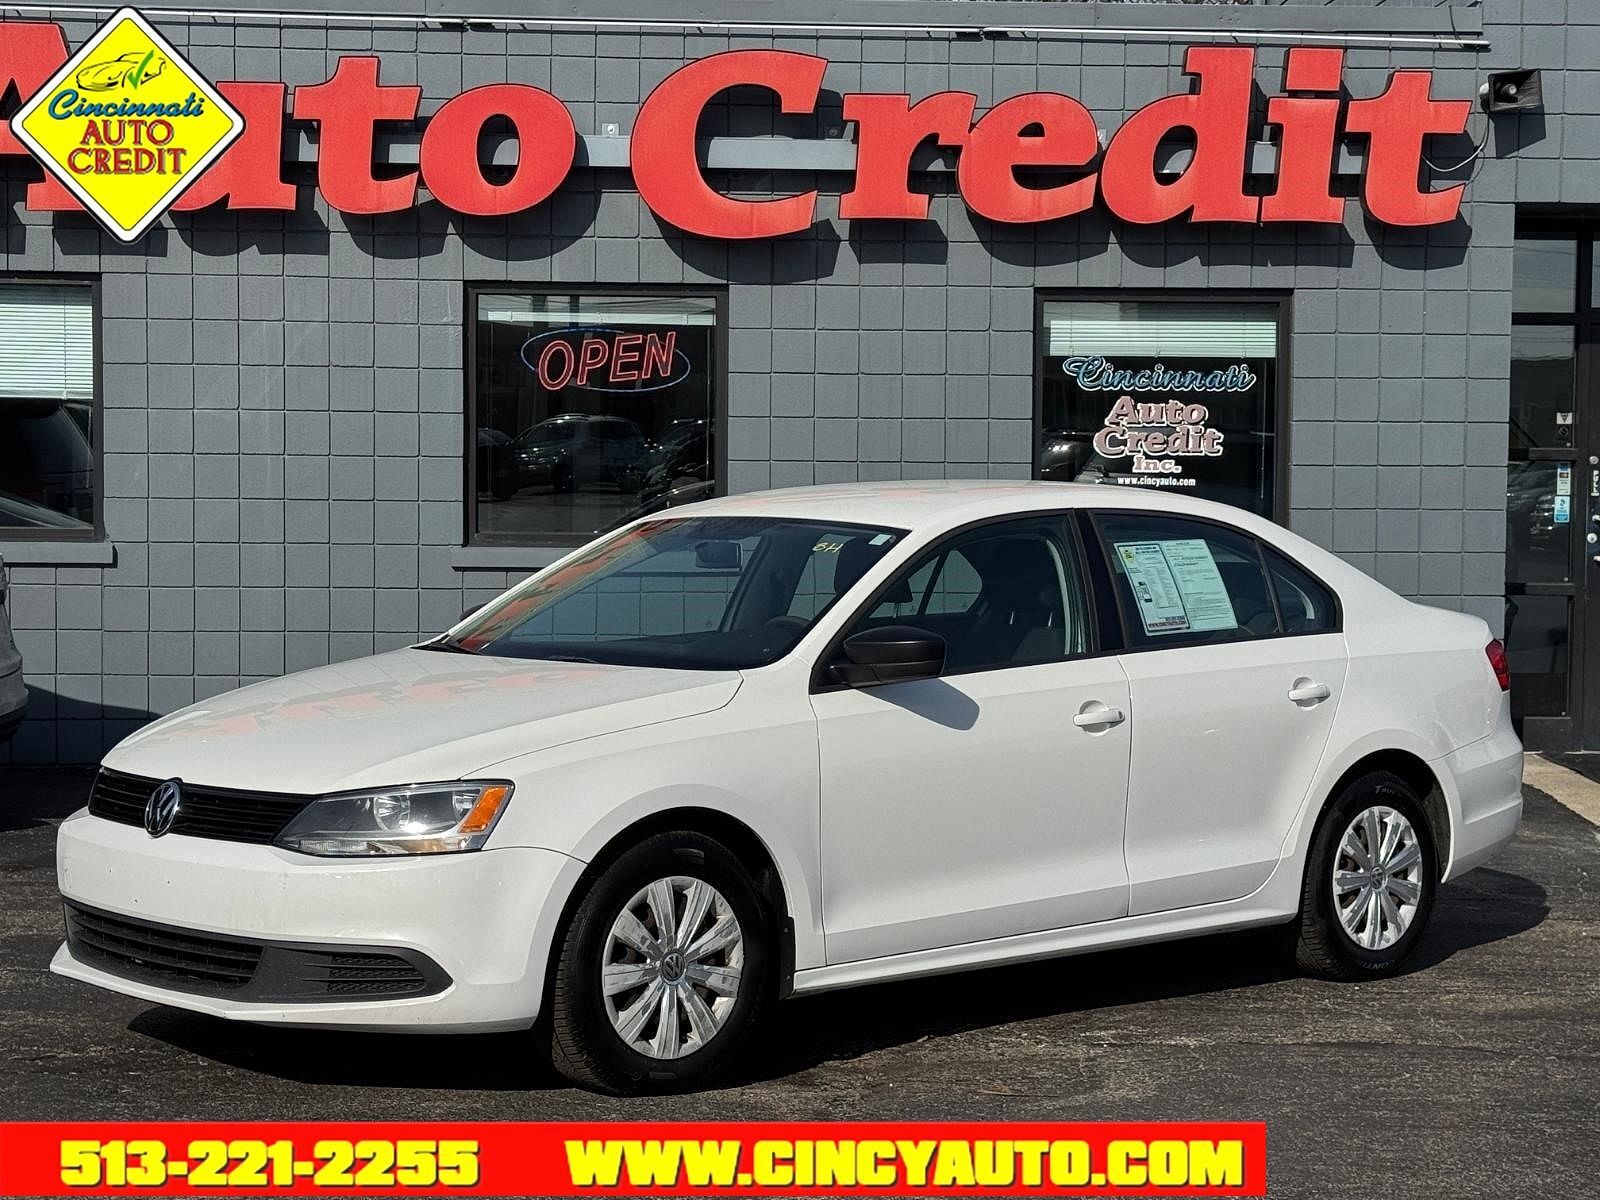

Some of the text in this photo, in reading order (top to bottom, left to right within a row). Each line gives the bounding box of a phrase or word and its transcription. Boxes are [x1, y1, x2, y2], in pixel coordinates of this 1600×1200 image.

[630, 46, 1473, 239] Credit
[538, 331, 677, 391] OPEN
[1062, 355, 1257, 392] Cincinnati
[1104, 395, 1209, 427] Auto
[1093, 425, 1224, 458] Credit
[1117, 475, 1196, 487] www.cincyauto.com
[1132, 455, 1182, 474] Inc.
